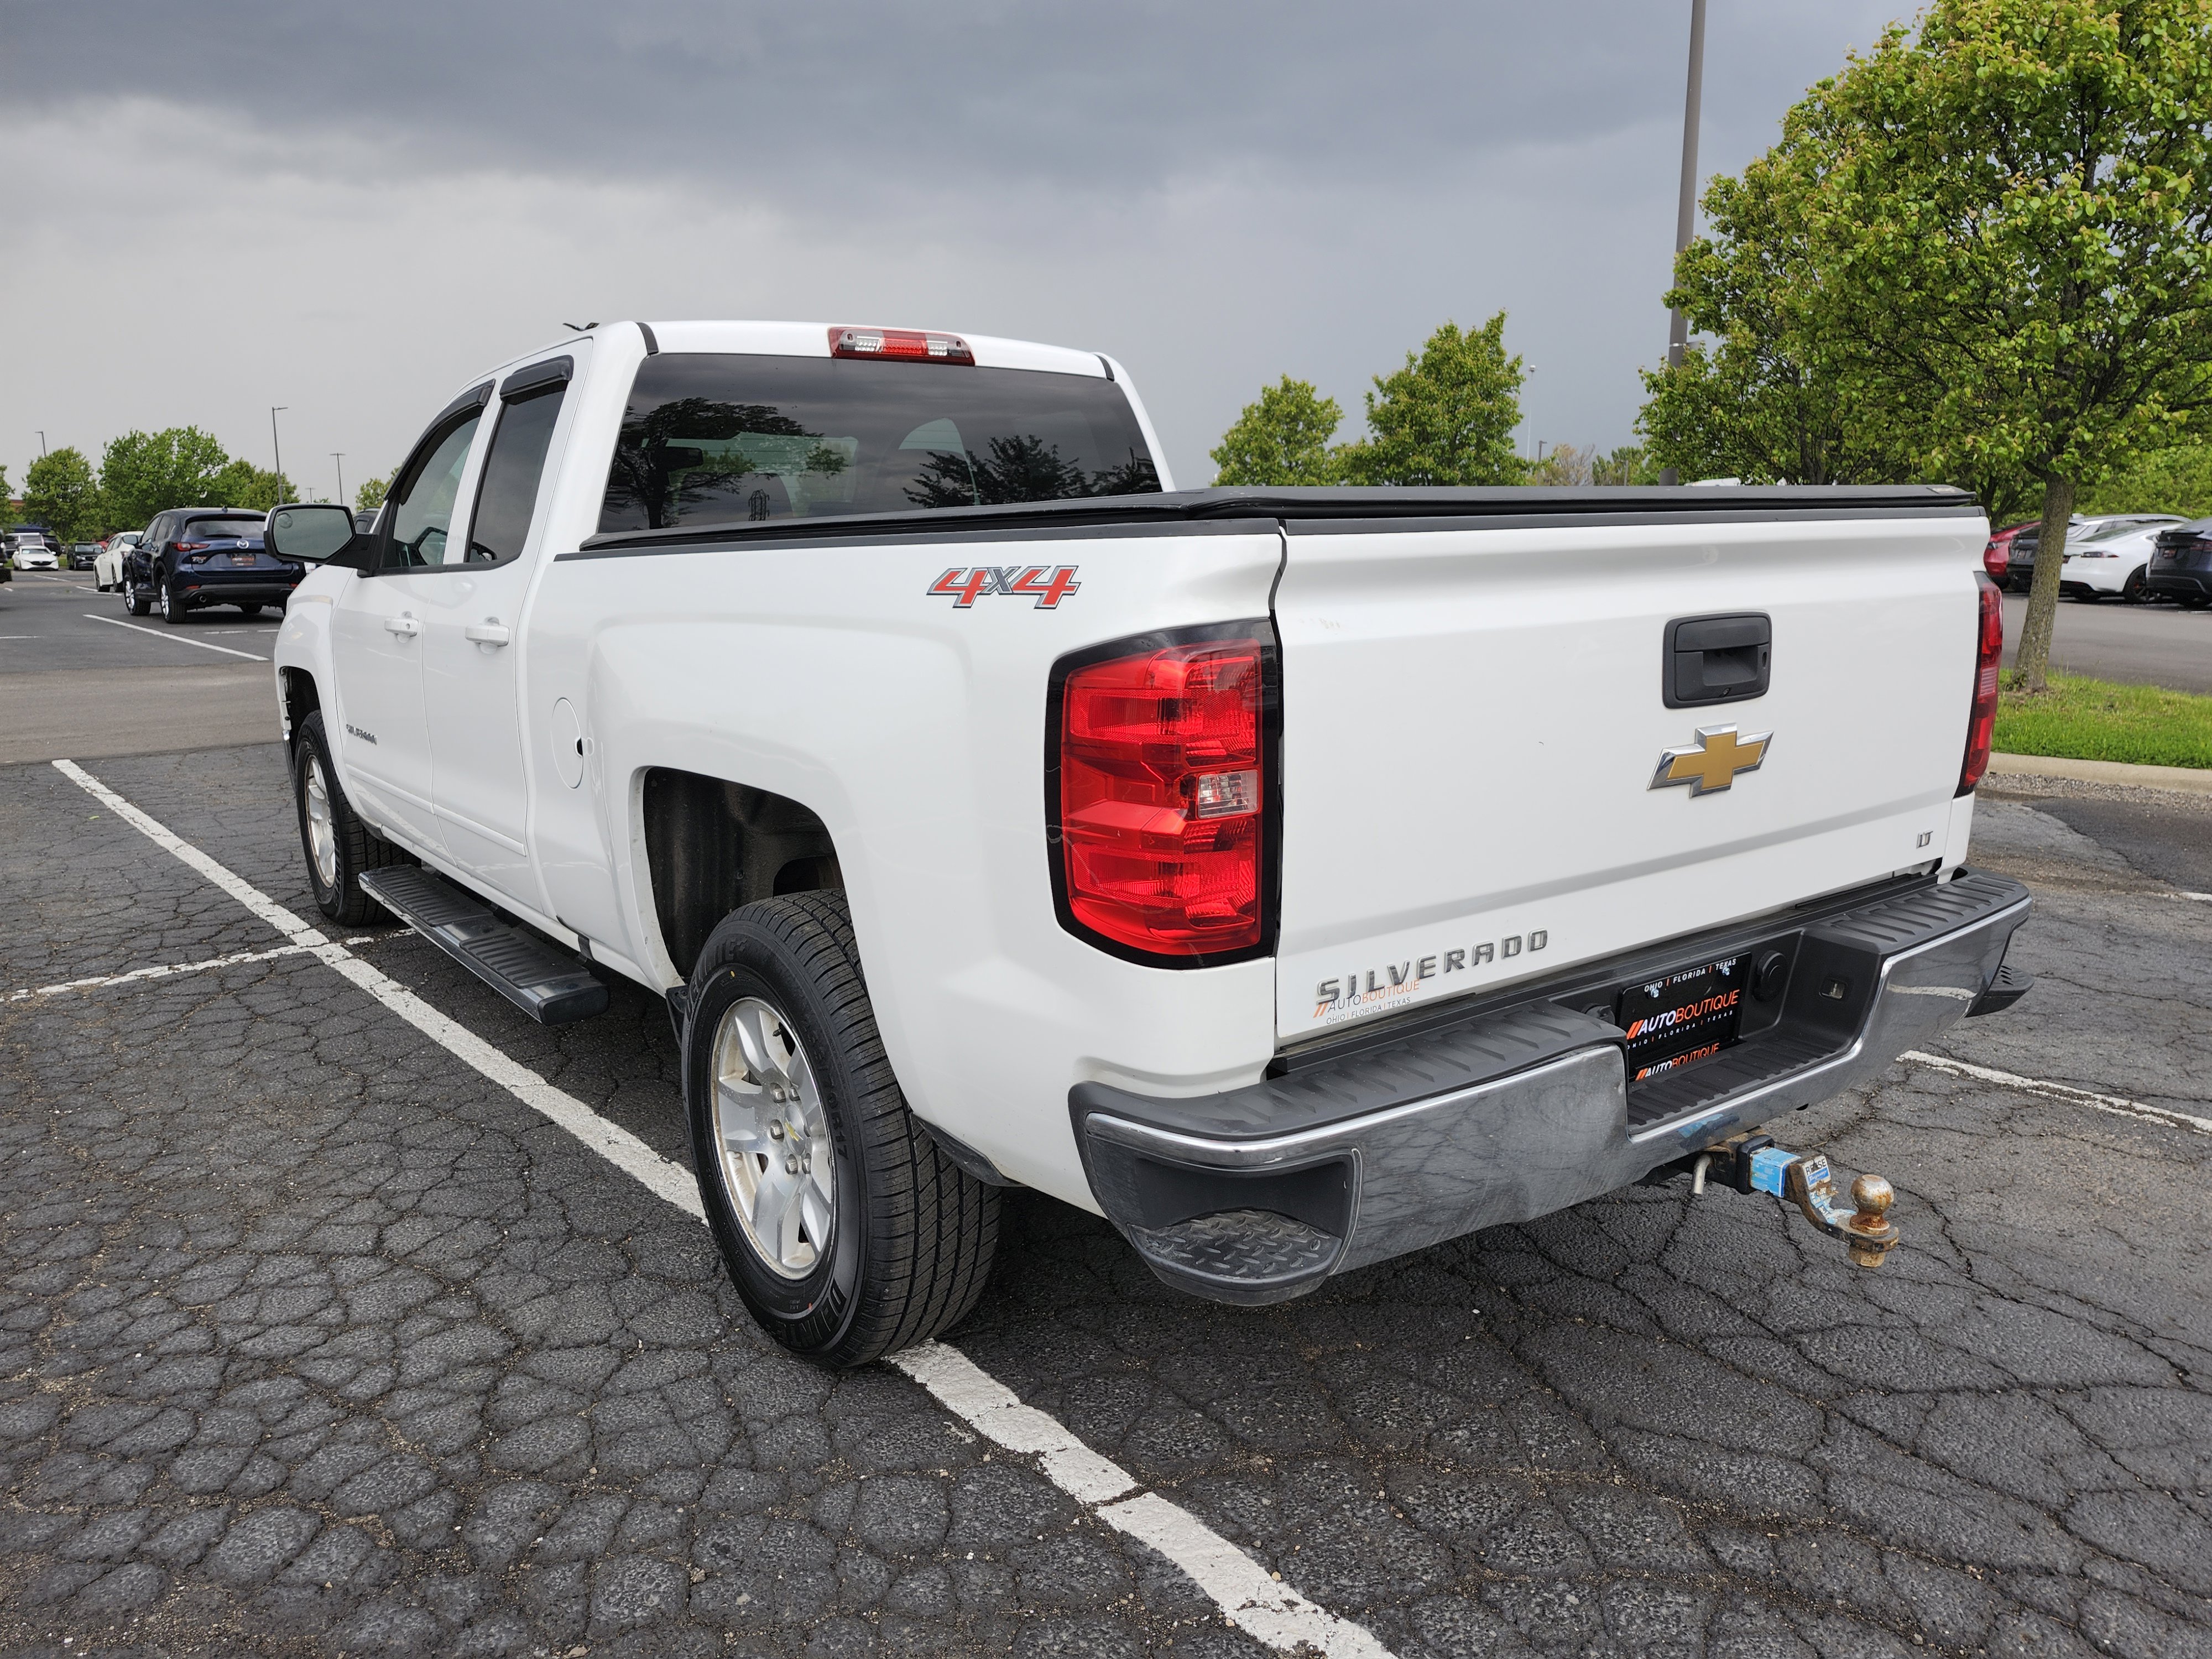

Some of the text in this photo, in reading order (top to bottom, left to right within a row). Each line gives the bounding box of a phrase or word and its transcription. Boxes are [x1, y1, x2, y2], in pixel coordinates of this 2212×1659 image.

[1316, 928, 1548, 1005] SILVERADO
[1644, 958, 1736, 993] OHIO FLORIDA TEXAS
[1326, 997, 1411, 1025] OHIO FLORIDA TEXAS
[1327, 978, 1420, 1013] AUTOBOUTIQUE
[1637, 989, 1740, 1036] AUTOBOUTIQUE
[1658, 1023, 1695, 1040] FLORIDA
[1707, 1010, 1733, 1022] TEXAS
